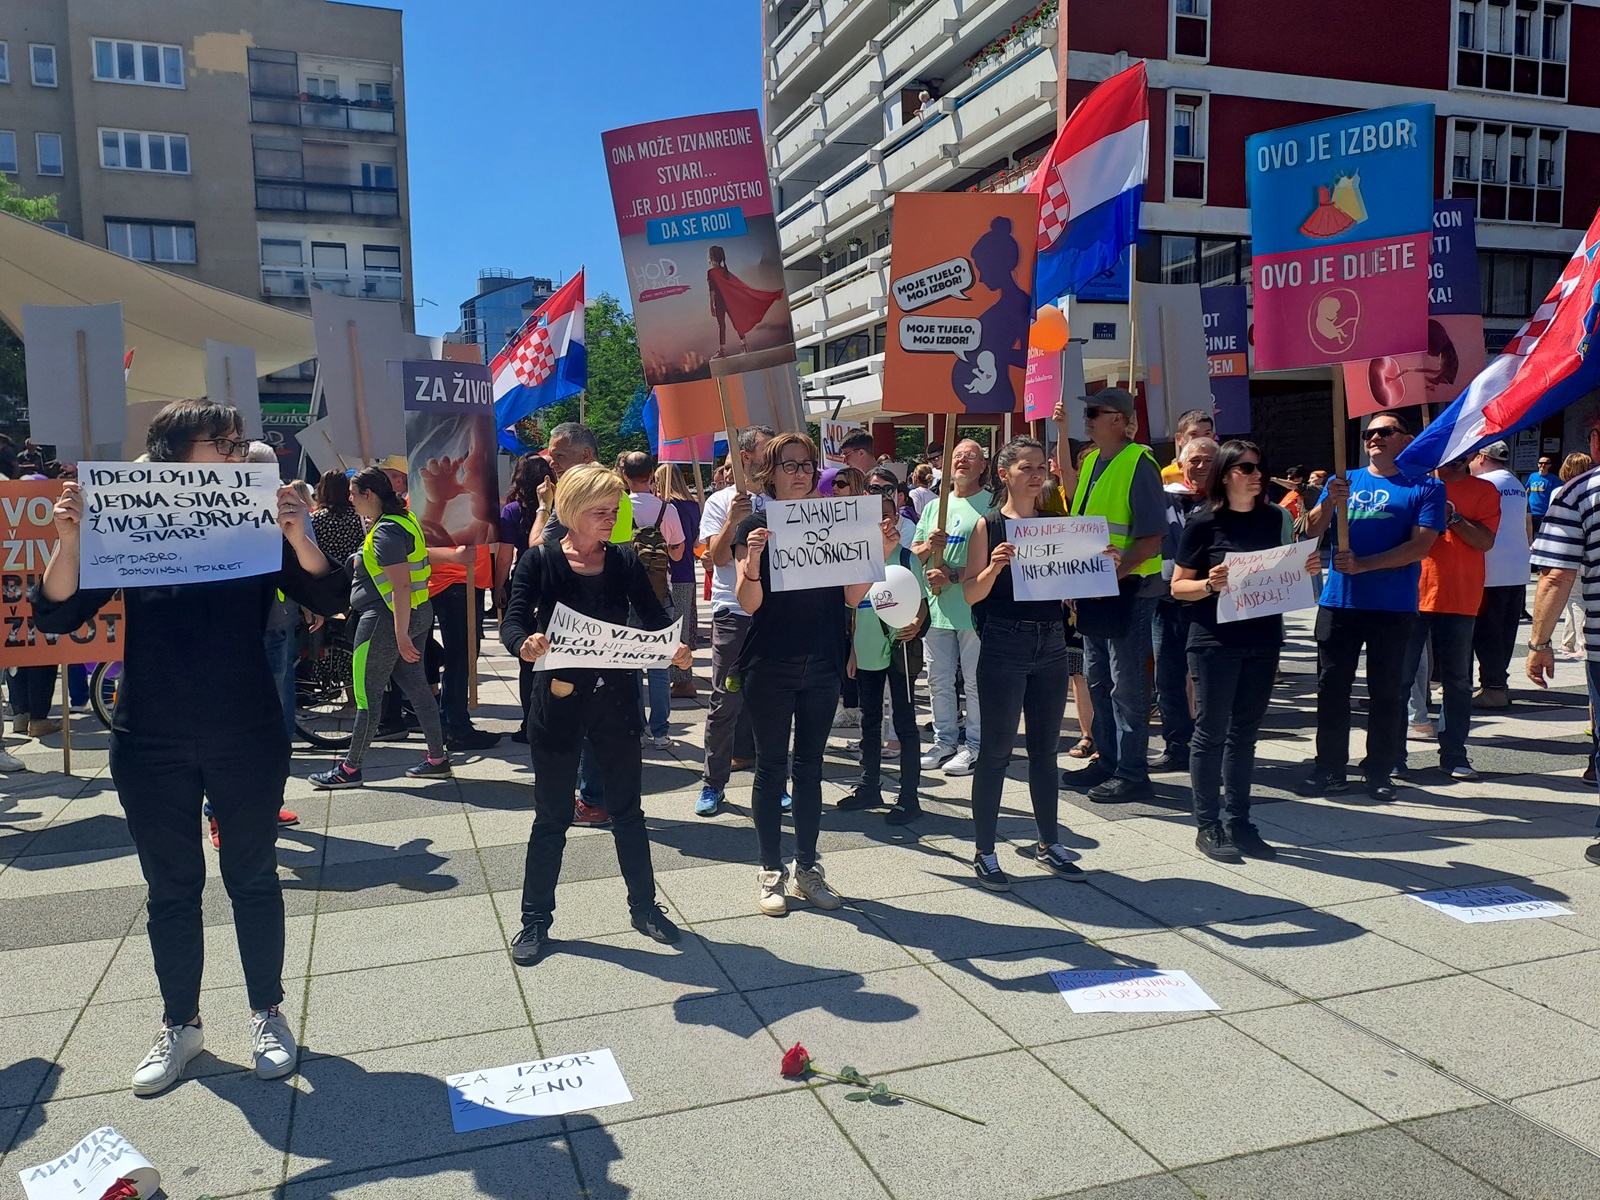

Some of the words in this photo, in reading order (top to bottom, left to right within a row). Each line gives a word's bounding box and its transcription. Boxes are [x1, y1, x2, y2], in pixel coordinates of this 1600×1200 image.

[612, 144, 636, 165] ONA
[637, 135, 674, 160] MOŽE
[677, 126, 752, 153] IZVANREDNE
[1257, 140, 1298, 172] OVO
[1306, 132, 1331, 162] JE
[1340, 118, 1418, 157] IZBOR
[657, 161, 717, 185] STVARI...
[656, 194, 677, 213] JOJ
[661, 220, 680, 240] DA
[684, 219, 698, 237] SE
[702, 212, 731, 232] RODI
[632, 258, 678, 285] HOD
[1261, 261, 1302, 290] OVO
[1309, 256, 1335, 285] JE
[1343, 241, 1415, 280] DIJETE
[897, 276, 927, 296] MOJE
[927, 264, 966, 284] TIJELO,
[907, 287, 930, 302] MOJ
[930, 275, 962, 294] IZBOR!
[906, 324, 935, 334] MOJE
[938, 325, 976, 335] TIJELO,
[912, 335, 935, 345] MOJ
[936, 335, 969, 345] IZBOR!
[415, 376, 447, 402] ZA
[452, 372, 492, 405] ŽIVOT
[228, 470, 262, 488] JE
[89, 491, 170, 514] JEDNA
[785, 499, 858, 529] ZNANJEM
[89, 512, 154, 534] ŽIVOT
[155, 511, 182, 529] JE
[189, 509, 276, 529] DRUGA
[1014, 525, 1038, 538] AKO
[1040, 523, 1067, 536] NISTE
[803, 527, 832, 545] DO
[90, 553, 125, 566] JOSIP
[772, 540, 870, 571] ODGOVORNOSTI
[1017, 543, 1064, 560] NISTE
[118, 565, 188, 577] DOMOVINSKI
[194, 562, 244, 574] POKRET
[1021, 556, 1111, 581] INFORMIRANE
[1240, 579, 1252, 590] JE
[1259, 576, 1274, 587] ZA
[1279, 569, 1301, 587] NJU
[553, 608, 602, 636] NIKAD
[452, 1073, 489, 1090] ZA
[517, 1055, 596, 1077] IZBOR
[455, 1096, 496, 1113] ZA
[505, 1075, 583, 1103] ŽENU
